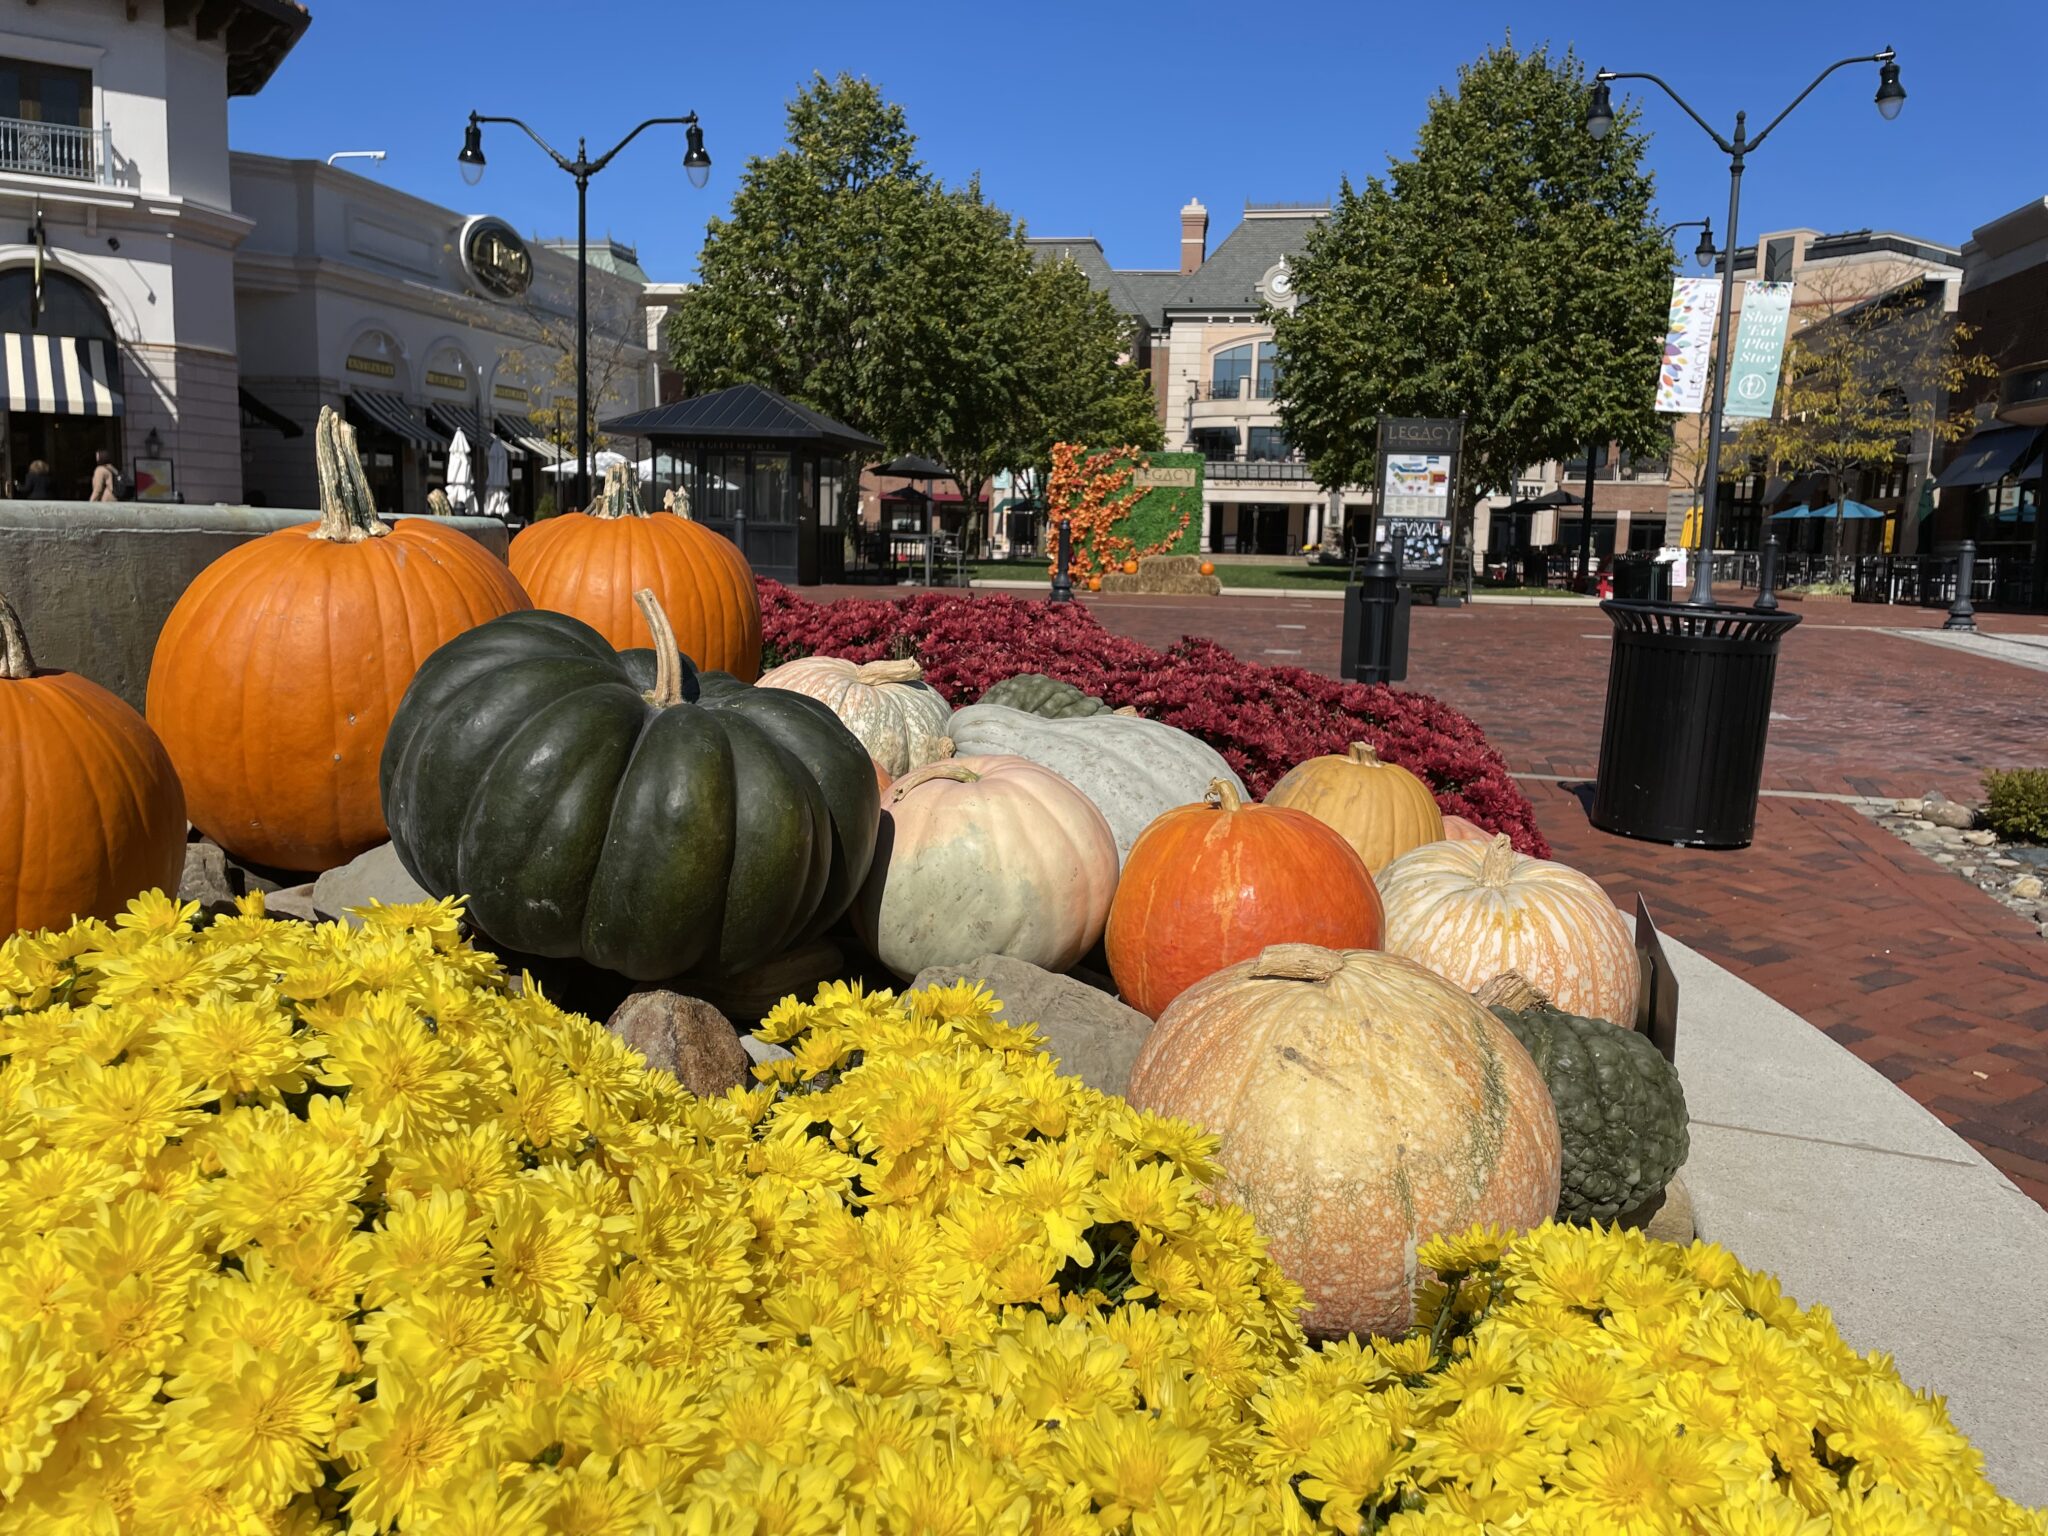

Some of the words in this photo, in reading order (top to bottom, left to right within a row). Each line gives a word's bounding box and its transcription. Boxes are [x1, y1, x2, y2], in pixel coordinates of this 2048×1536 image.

[1694, 292, 1716, 348] VILLAGE
[1744, 310, 1783, 326] Shop
[1747, 324, 1777, 337] Eat
[1742, 337, 1779, 353] Play
[1739, 352, 1776, 366] Stay
[1686, 347, 1708, 399] LEGACY
[1388, 425, 1454, 440] LEGACY
